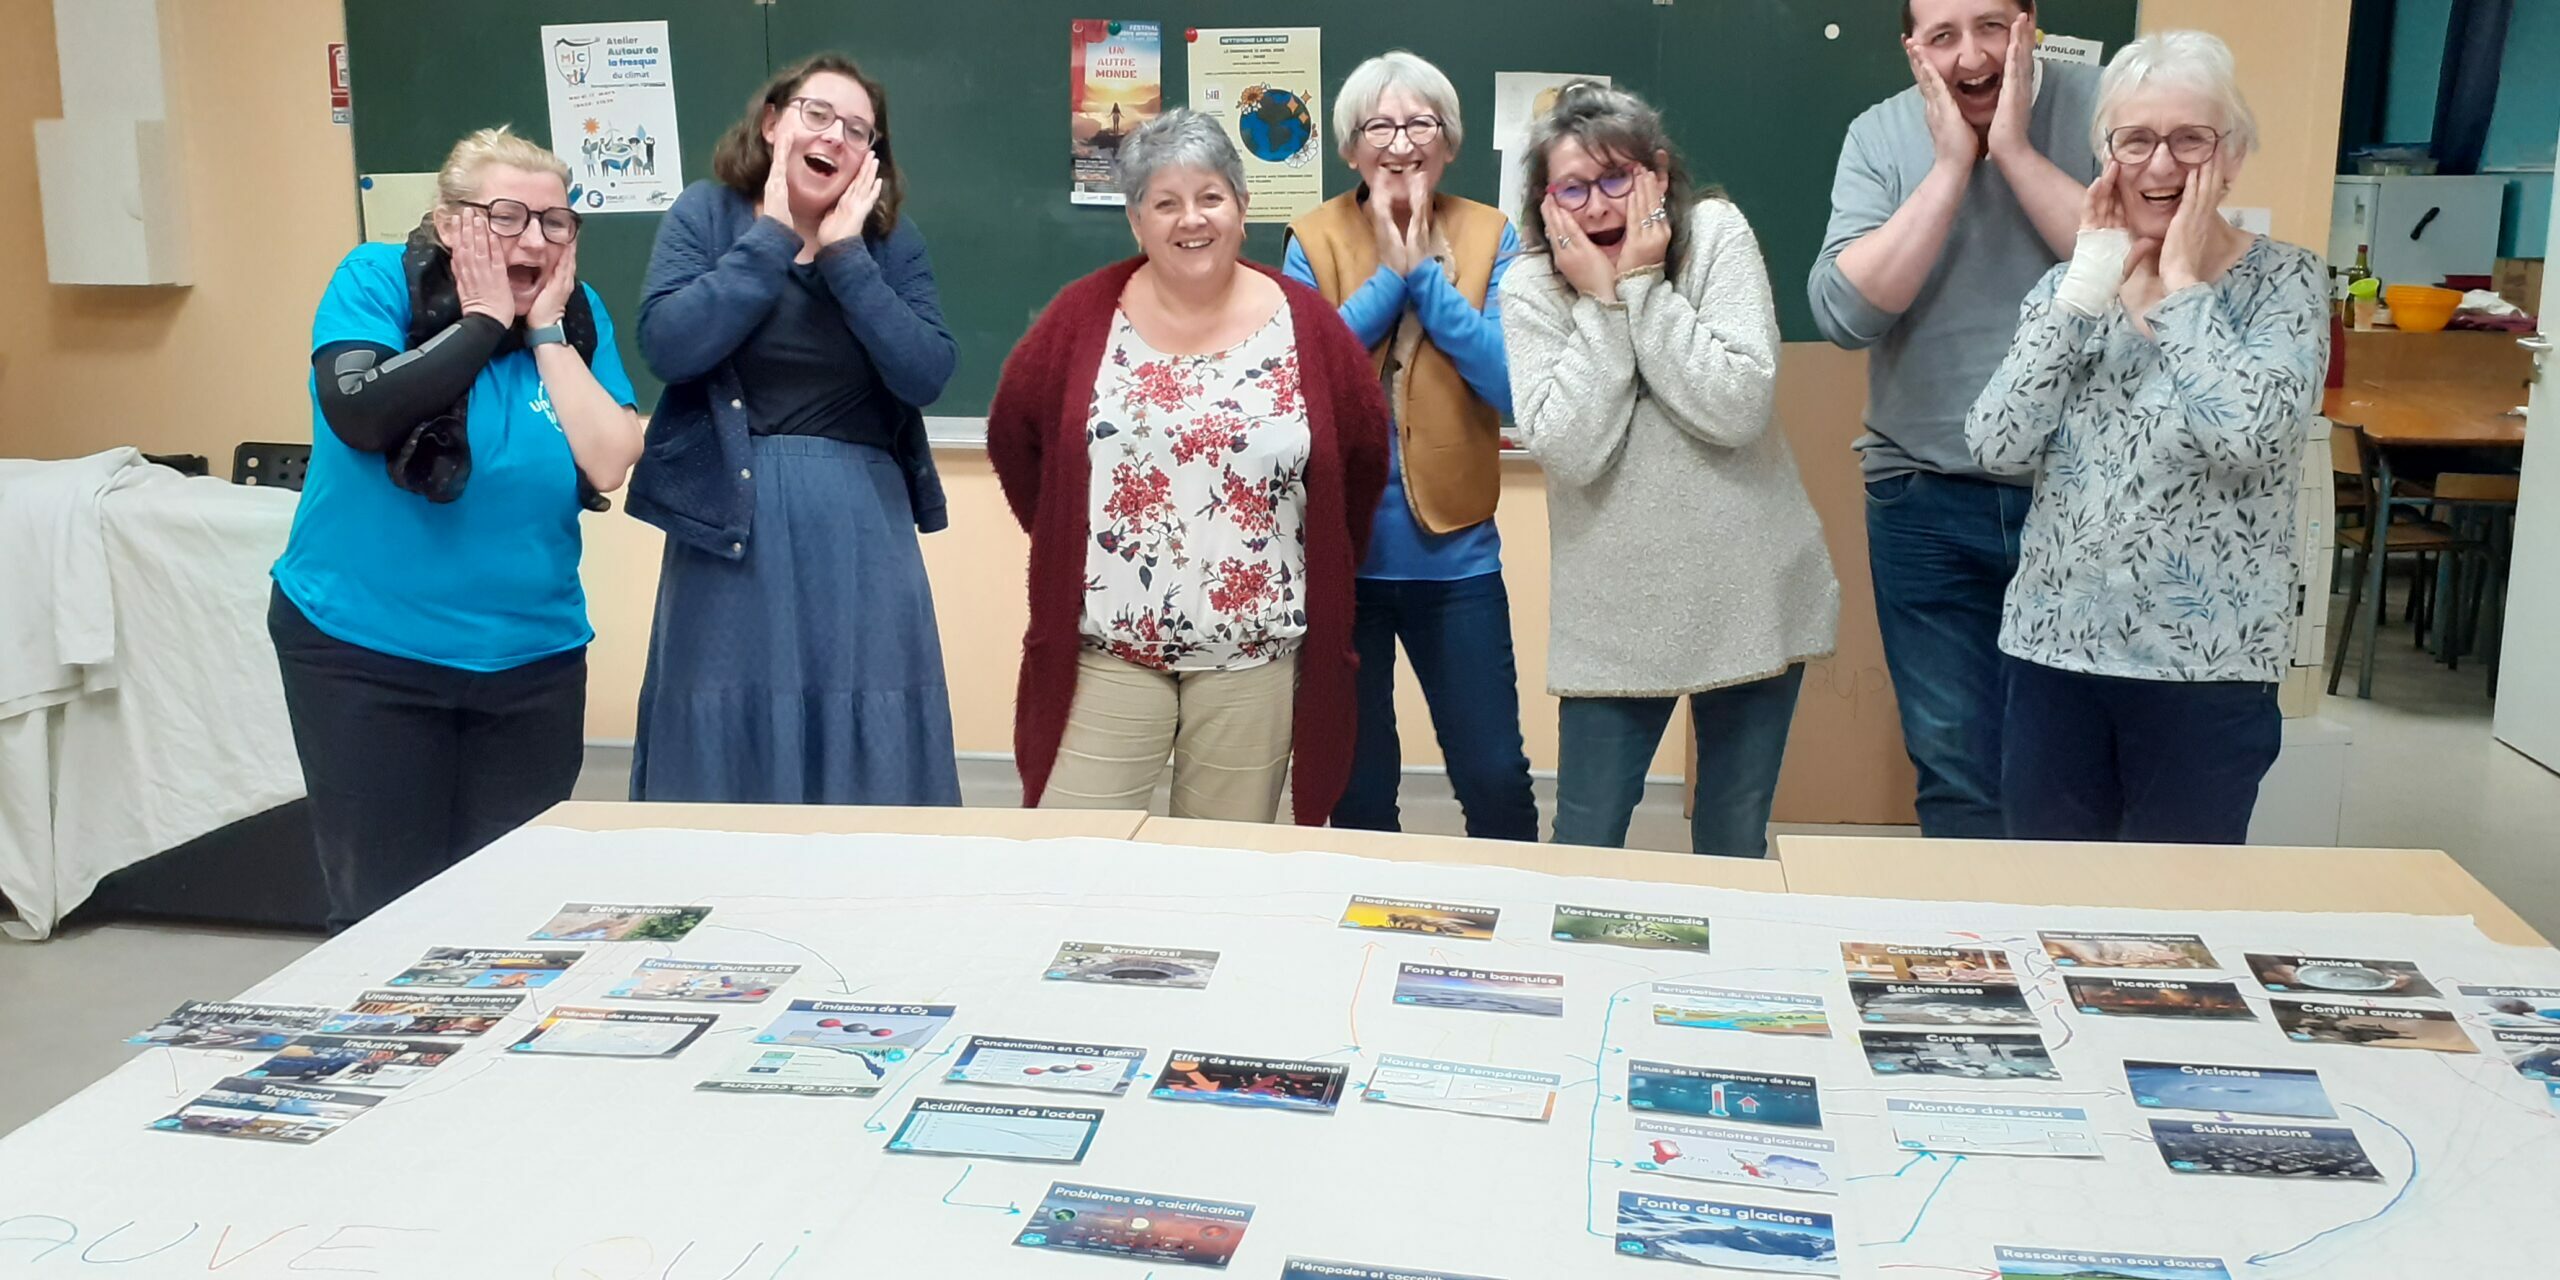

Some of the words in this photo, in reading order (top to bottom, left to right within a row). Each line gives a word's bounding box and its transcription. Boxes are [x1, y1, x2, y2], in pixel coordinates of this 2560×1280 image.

[606, 36, 638, 45] Atelier
[608, 48, 644, 56] Autour
[645, 46, 659, 54] de
[1109, 46, 1125, 54] UN
[2044, 45, 2086, 56] VOULOIR
[560, 50, 585, 65] MJC
[608, 58, 618, 66] la
[619, 58, 657, 69] fresque
[1097, 58, 1136, 67] AUTRE
[612, 71, 623, 79] du
[624, 71, 650, 79] climat
[1095, 69, 1137, 79] MONDE
[588, 904, 682, 915] Déforestation
[1354, 895, 1433, 910] Biodiversité
[1435, 902, 1496, 916] terrestre
[1559, 906, 1621, 919] Vecteurs
[1624, 913, 1644, 921] de
[1647, 916, 1705, 926] maladie
[464, 949, 544, 961] Agriculture
[1101, 945, 1182, 958] Permafrost
[1886, 946, 1959, 958] Canicules
[708, 961, 758, 972] d'autres
[2297, 957, 2363, 969] Famines
[1404, 965, 1447, 977] Fonte
[1449, 967, 1469, 978] de
[1471, 968, 1487, 979] la
[1489, 971, 1558, 986] banquise
[1886, 983, 1984, 996] Sécheresses
[2111, 979, 2188, 990] Incendies
[364, 992, 425, 1004] Utilisation
[428, 995, 451, 1004] des
[452, 993, 518, 1006] bâtiments
[1657, 984, 1725, 998] Perturbation
[1727, 990, 1743, 999] du
[1745, 992, 1774, 1004] cycle
[1776, 994, 1789, 1003] de
[1790, 995, 1817, 1005] l'eau
[2486, 988, 2538, 997] Santé
[878, 1005, 897, 1014] de
[2300, 1003, 2367, 1017] Conflits
[2368, 1007, 2423, 1020] armés
[341, 1039, 409, 1051] Industrie
[1925, 1033, 1974, 1044] Crues
[974, 1038, 1055, 1052] Concentration
[1057, 1045, 1072, 1053] en
[1102, 1047, 1140, 1059] (ppm)
[1173, 1052, 1206, 1063] Effet
[1208, 1055, 1227, 1065] de
[1229, 1058, 1262, 1068] serre
[1265, 1059, 1344, 1074] additionnel
[1381, 1056, 1431, 1069] Hausse
[1432, 1060, 1452, 1070] de
[1454, 1062, 1469, 1072] la
[1470, 1064, 1555, 1083] température
[1633, 1063, 1670, 1074] Hausse
[1672, 1067, 1687, 1076] de
[1688, 1069, 1699, 1077] la
[1701, 1070, 1767, 1084] température
[1769, 1076, 1784, 1085] de
[1785, 1078, 1811, 1088] l'eau
[2180, 1064, 2261, 1078] Cyclones
[260, 1084, 336, 1102] Transport
[720, 1082, 789, 1091] carbone
[917, 1100, 1015, 1116] Acidification
[1017, 1106, 1039, 1117] de
[1041, 1107, 1097, 1121] l'océan
[1908, 1101, 1981, 1115] Montée
[1983, 1105, 2017, 1116] des
[2019, 1109, 2064, 1119] eaux
[1640, 1121, 1675, 1133] Fonte
[1680, 1126, 1703, 1136] des
[1707, 1129, 1759, 1142] calottes
[1763, 1135, 1829, 1150] glaciaires
[2191, 1122, 2313, 1139] Submersions
[1054, 1186, 1130, 1204] Problèmes
[1133, 1196, 1153, 1206] de
[1157, 1199, 1246, 1217] calcification
[1637, 1197, 1690, 1212] Fonte
[1695, 1203, 1731, 1216] des
[1736, 1208, 1813, 1226] glaciers
[2002, 1248, 2096, 1265] Ressources
[2101, 1256, 2123, 1266] en
[2126, 1257, 2159, 1267] eau
[2162, 1256, 2216, 1269] douce
[1291, 1261, 1367, 1278] Ptéropodes
[1370, 1271, 1384, 1279] et
